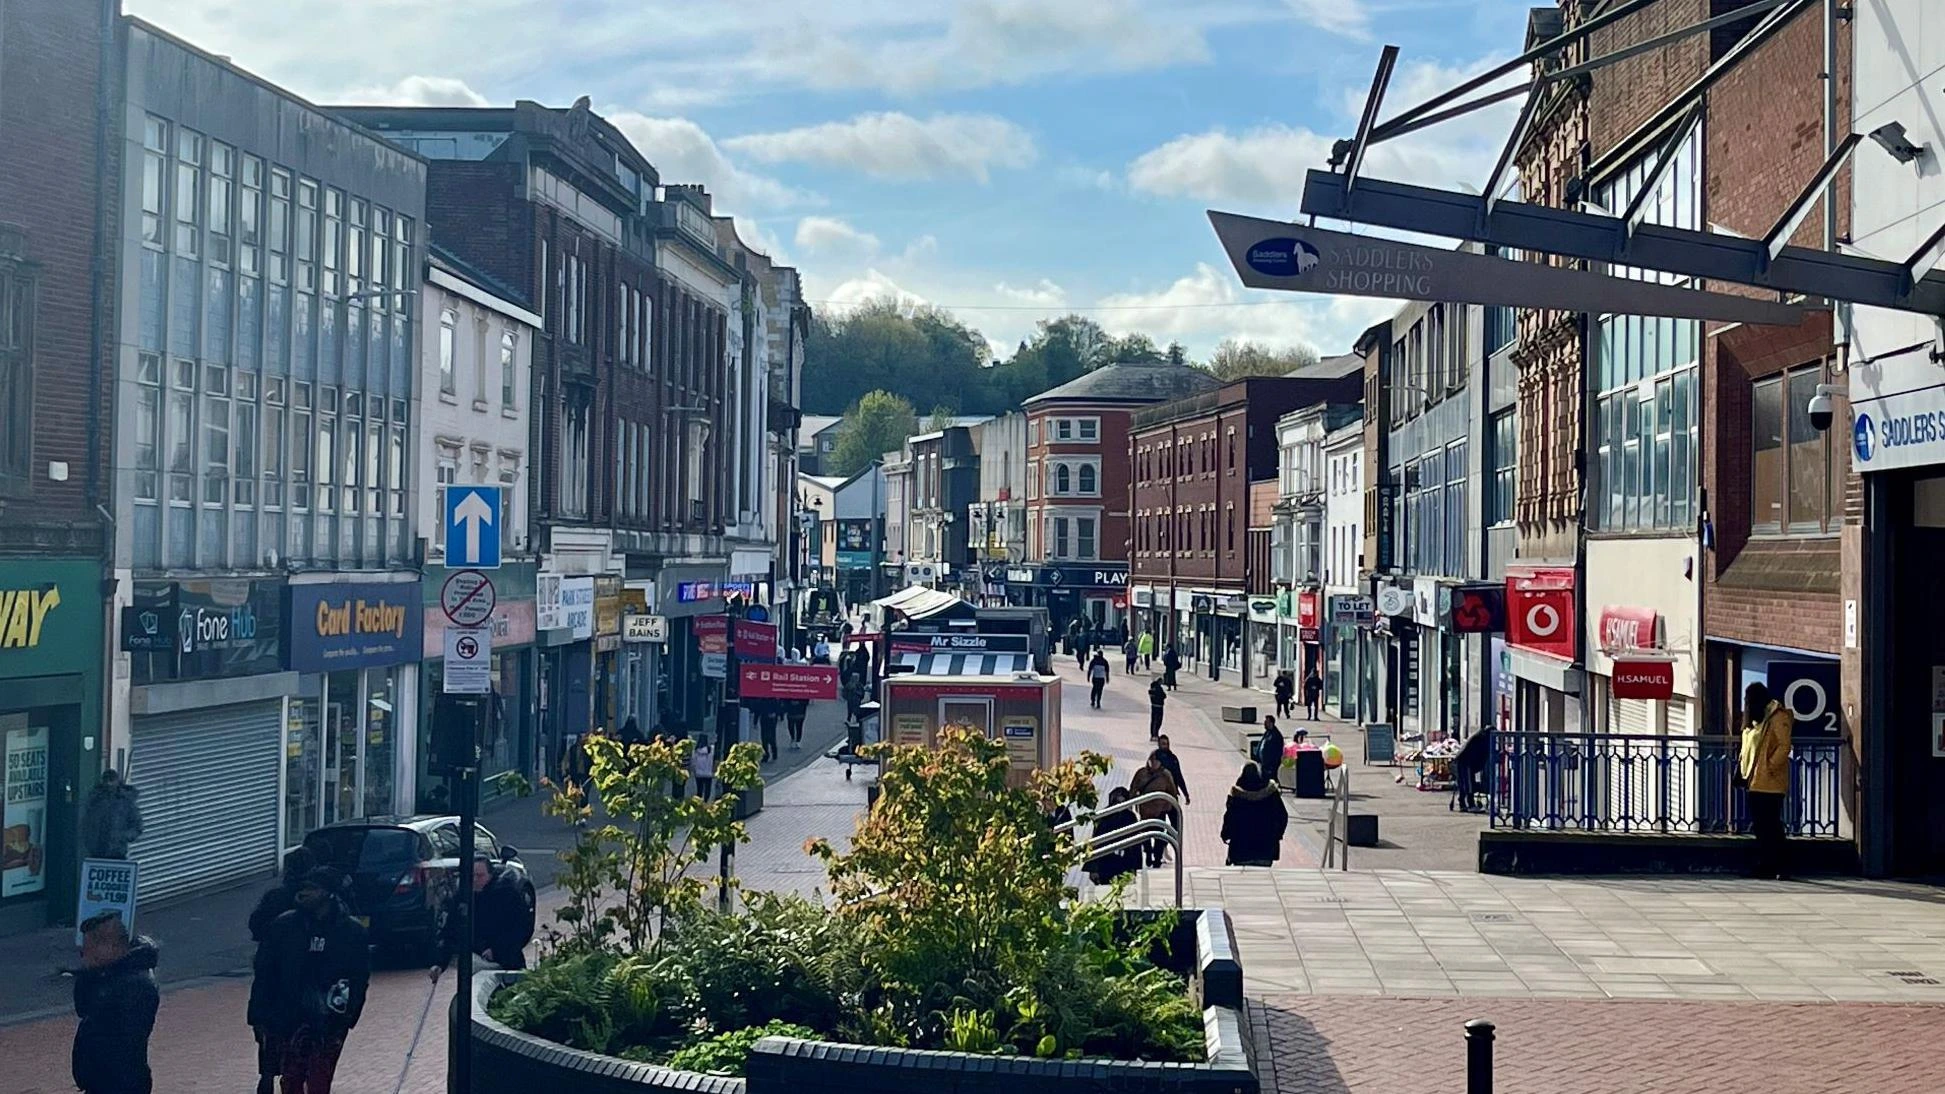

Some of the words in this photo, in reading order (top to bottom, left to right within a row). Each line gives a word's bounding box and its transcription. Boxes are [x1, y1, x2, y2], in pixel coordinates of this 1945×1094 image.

[1330, 247, 1434, 271] SADDLERS
[1326, 269, 1431, 295] SHOPPING
[1881, 411, 1936, 448] SADDLERS
[1094, 571, 1129, 584] PLAY
[1338, 602, 1351, 611] TO
[1353, 602, 1370, 611] LET
[231, 603, 257, 639] Hub
[317, 599, 352, 636] Card
[355, 599, 405, 639] Factory
[632, 617, 658, 627] JEFF
[628, 628, 661, 638] BAINS
[931, 636, 949, 647] Mr
[951, 636, 987, 647] Sizzle
[772, 672, 789, 681] Rail
[789, 673, 820, 683] Station
[20, 750, 46, 768] SEATS
[7, 782, 45, 801] UPSTAIRS
[88, 868, 130, 883] COFFEE
